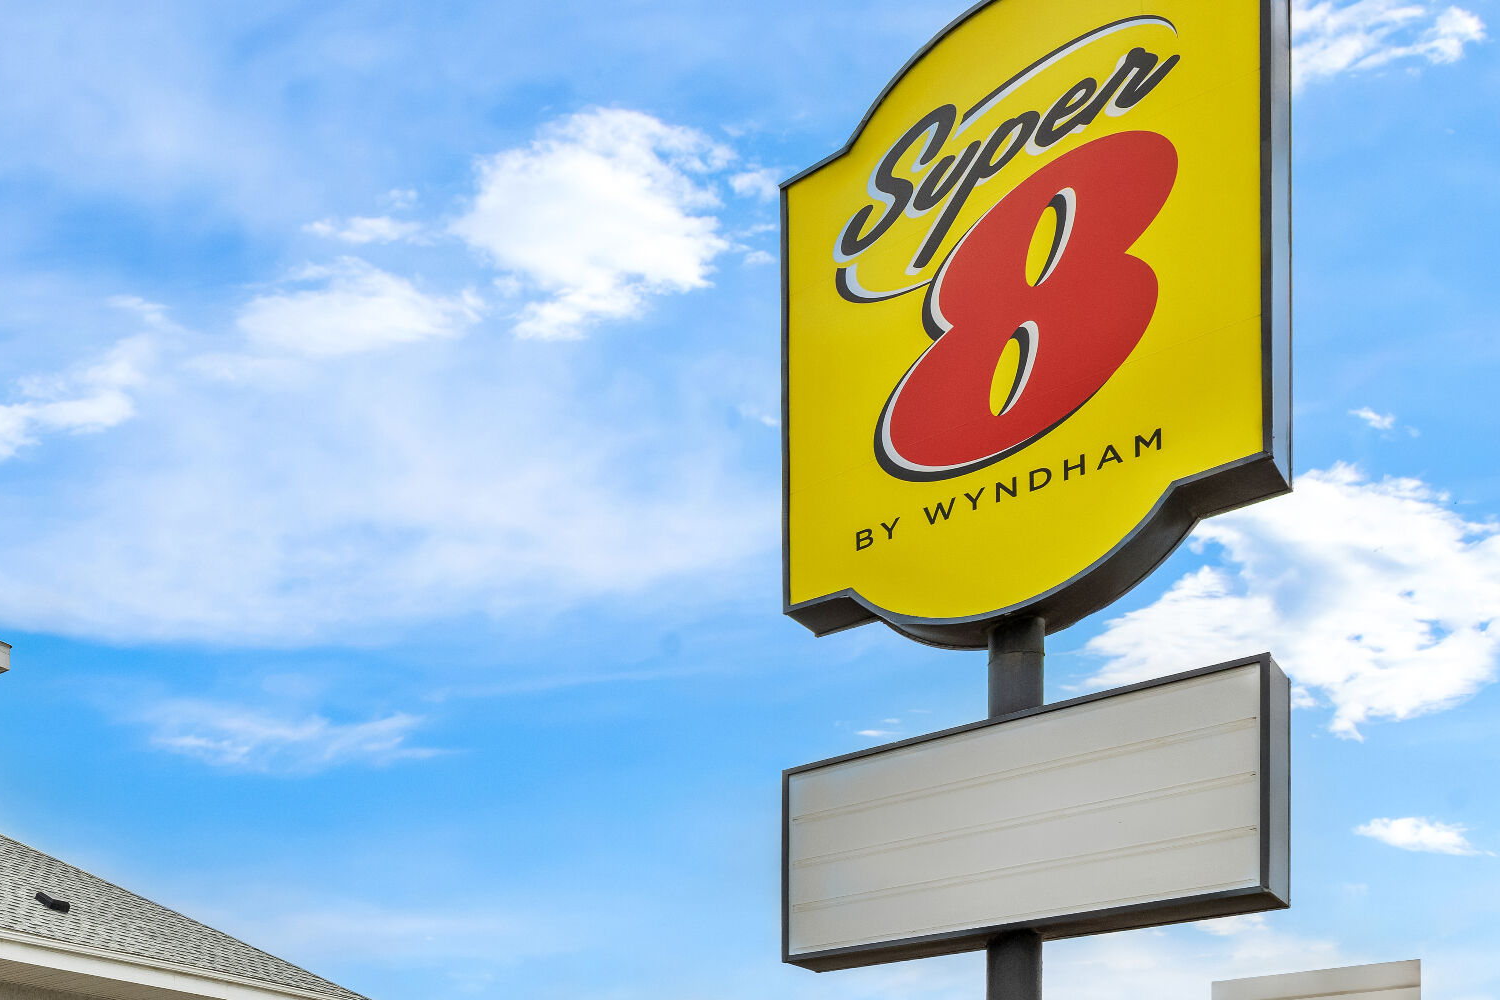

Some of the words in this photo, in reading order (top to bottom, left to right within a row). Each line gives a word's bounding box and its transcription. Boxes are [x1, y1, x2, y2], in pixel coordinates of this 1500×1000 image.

[836, 47, 1180, 273] Super
[874, 130, 1178, 482] 8
[855, 517, 901, 551] BY
[924, 428, 1163, 527] WYNDHAM
